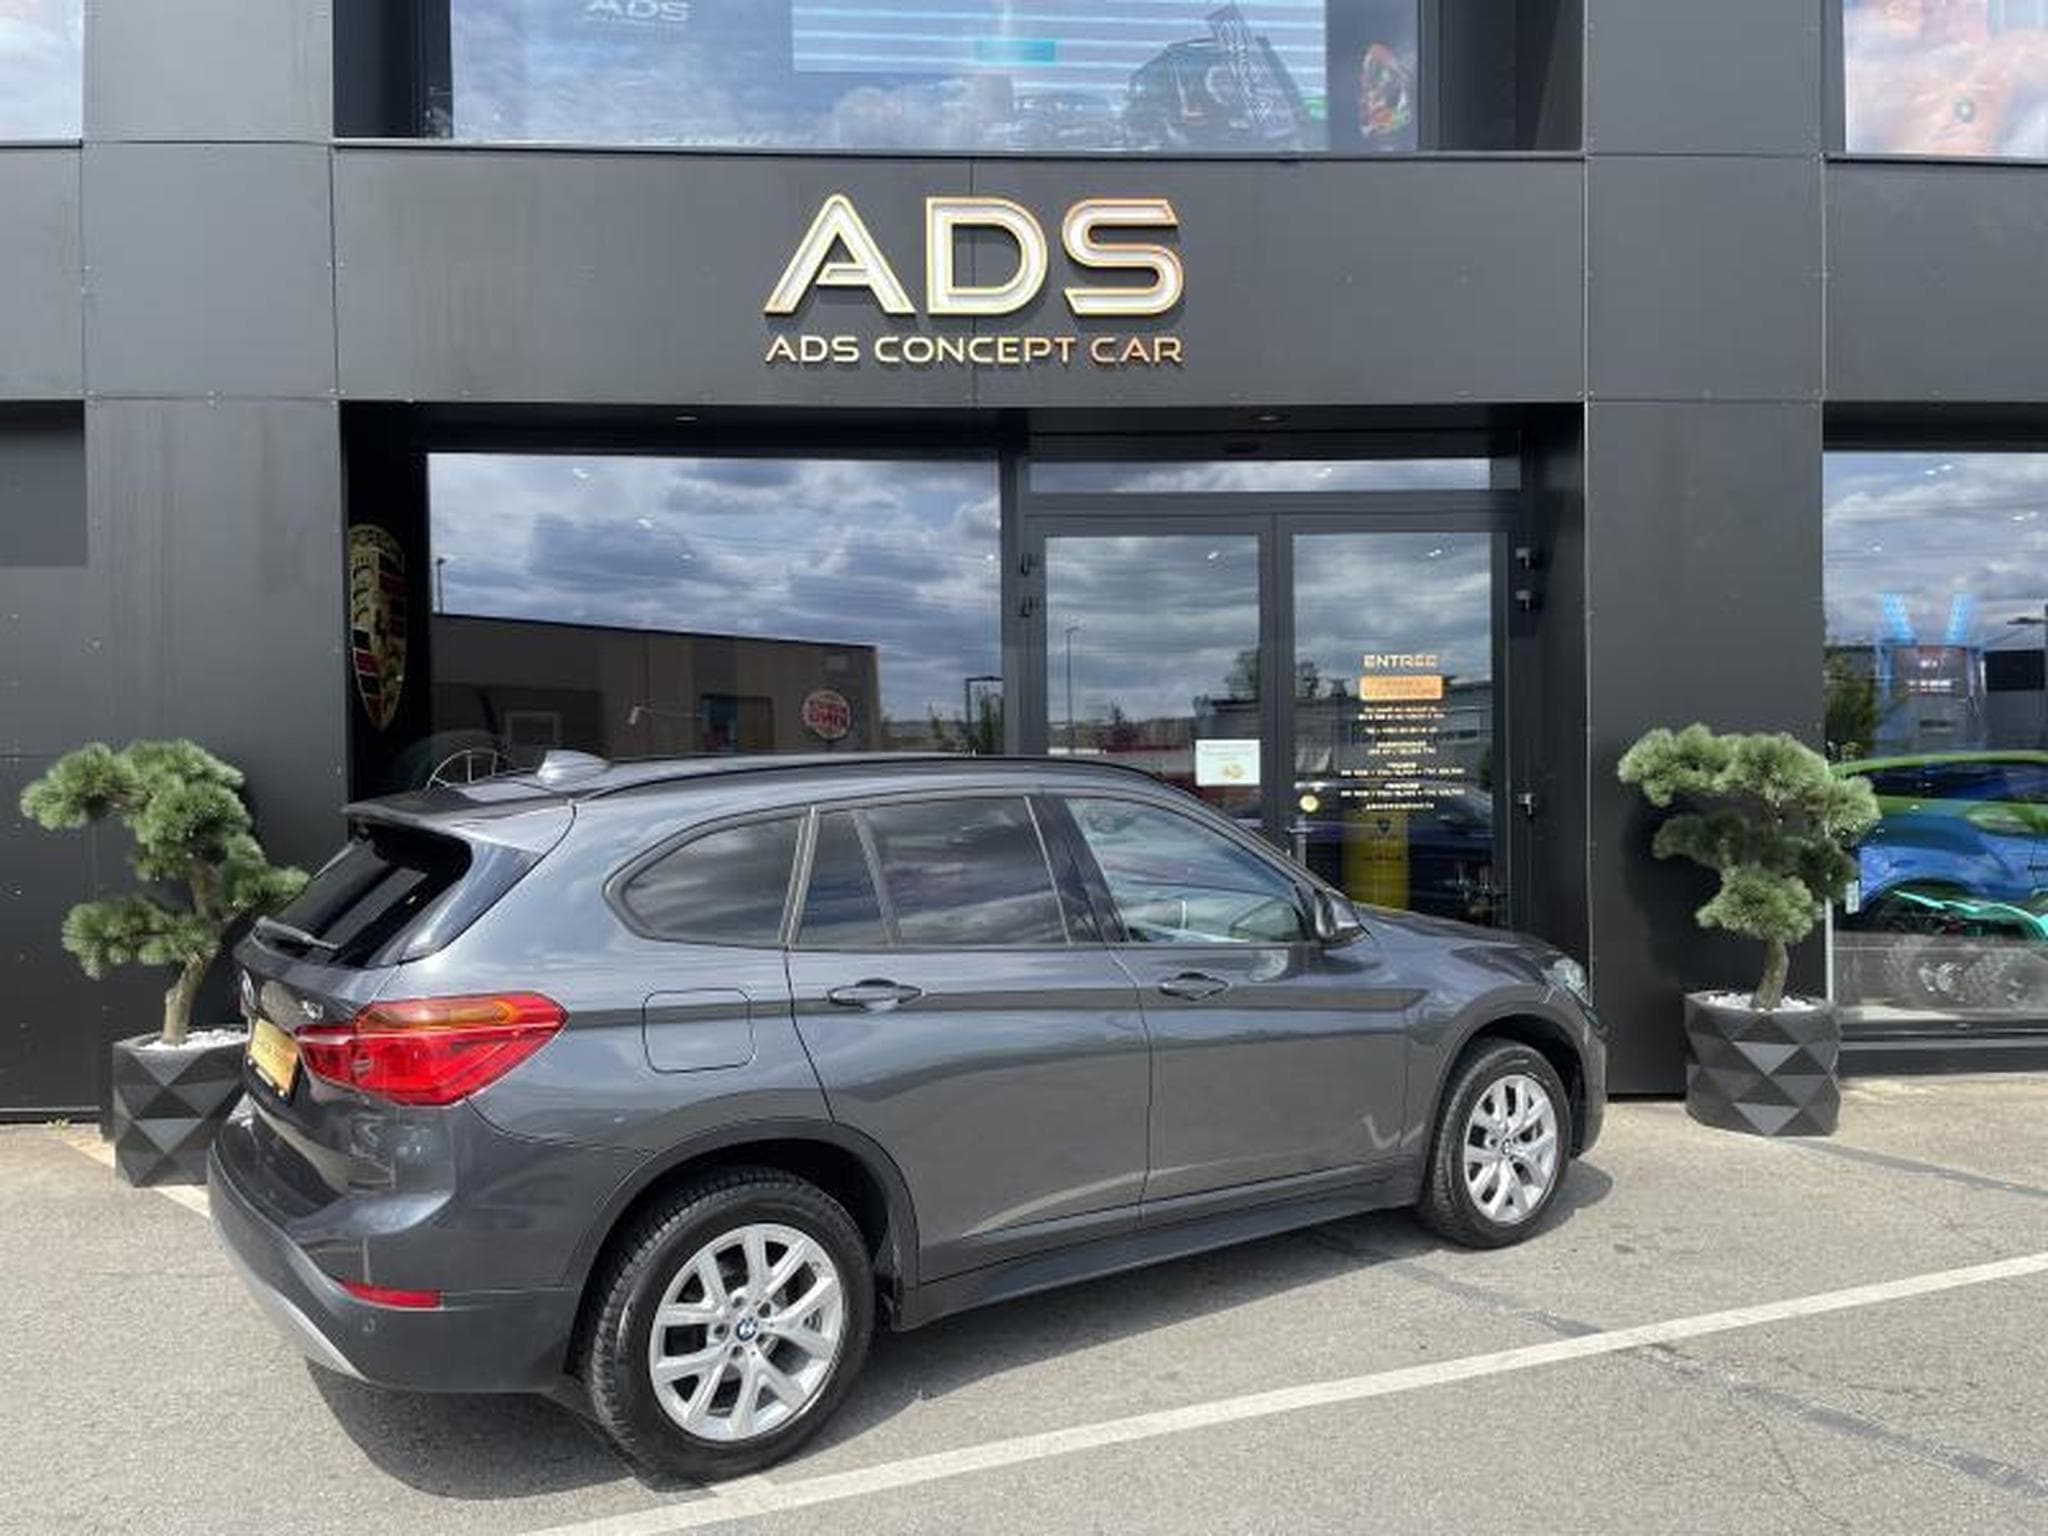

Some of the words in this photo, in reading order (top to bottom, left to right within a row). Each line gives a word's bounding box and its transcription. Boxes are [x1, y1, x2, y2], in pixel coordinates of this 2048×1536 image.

[763, 194, 1185, 316] ADS
[764, 335, 861, 364] ADS
[874, 335, 1076, 365] CONCEPT
[1090, 335, 1184, 365] CAR
